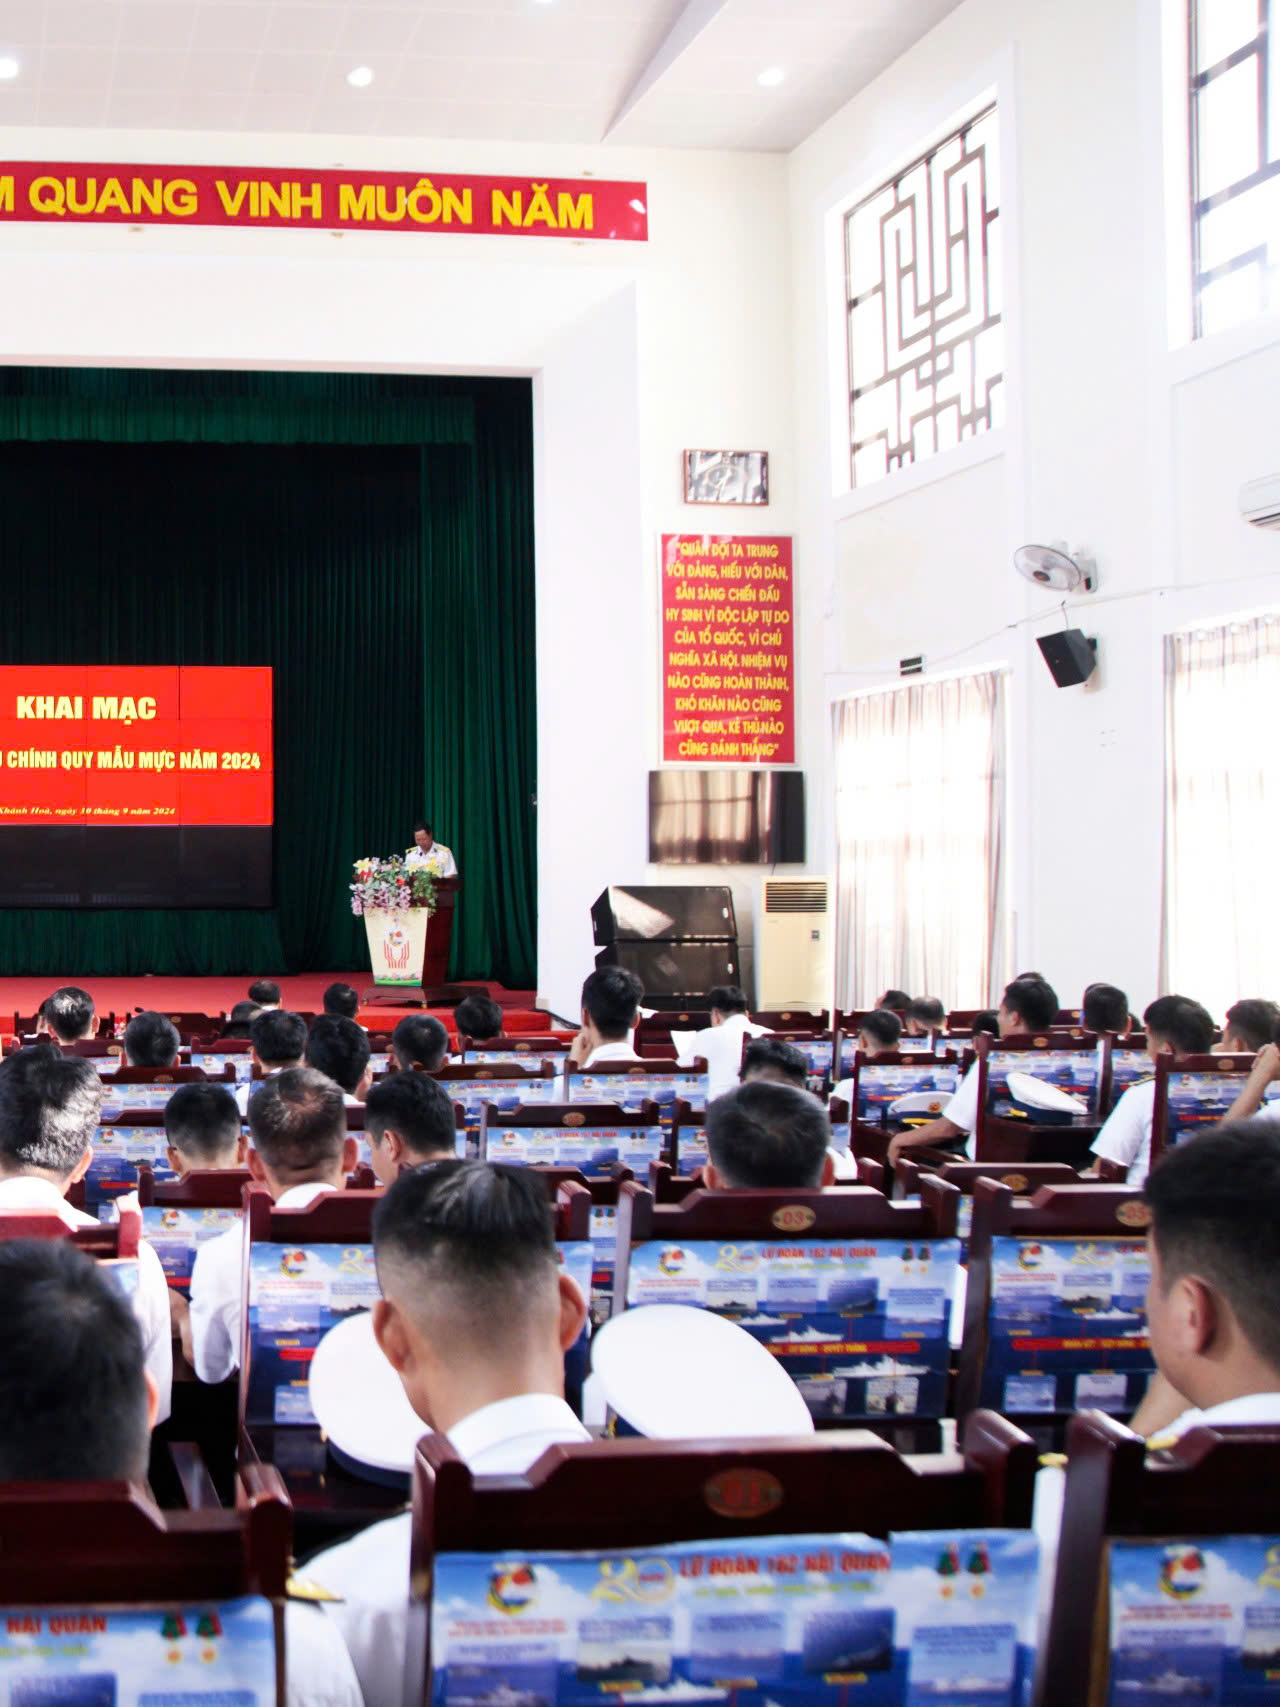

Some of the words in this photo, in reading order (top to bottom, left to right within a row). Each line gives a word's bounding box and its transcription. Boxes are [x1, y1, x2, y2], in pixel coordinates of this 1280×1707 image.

[28, 176, 198, 216] QUANG
[216, 180, 322, 218] VINH
[339, 180, 472, 223] MUÔN
[492, 183, 594, 229] NĂM
[16, 695, 82, 719] KHAI
[93, 696, 156, 725] MẠC
[7, 748, 57, 768] CHÍNH
[61, 752, 93, 769] QUY
[98, 745, 134, 769] MẪU
[138, 750, 175, 772] MỰC
[180, 749, 217, 769] NĂM
[221, 752, 261, 769] 2024
[55, 806, 77, 817] ngày
[81, 806, 92, 815] 10
[94, 806, 120, 817] tháng
[130, 807, 150, 815] năm
[152, 807, 175, 815] 2024
